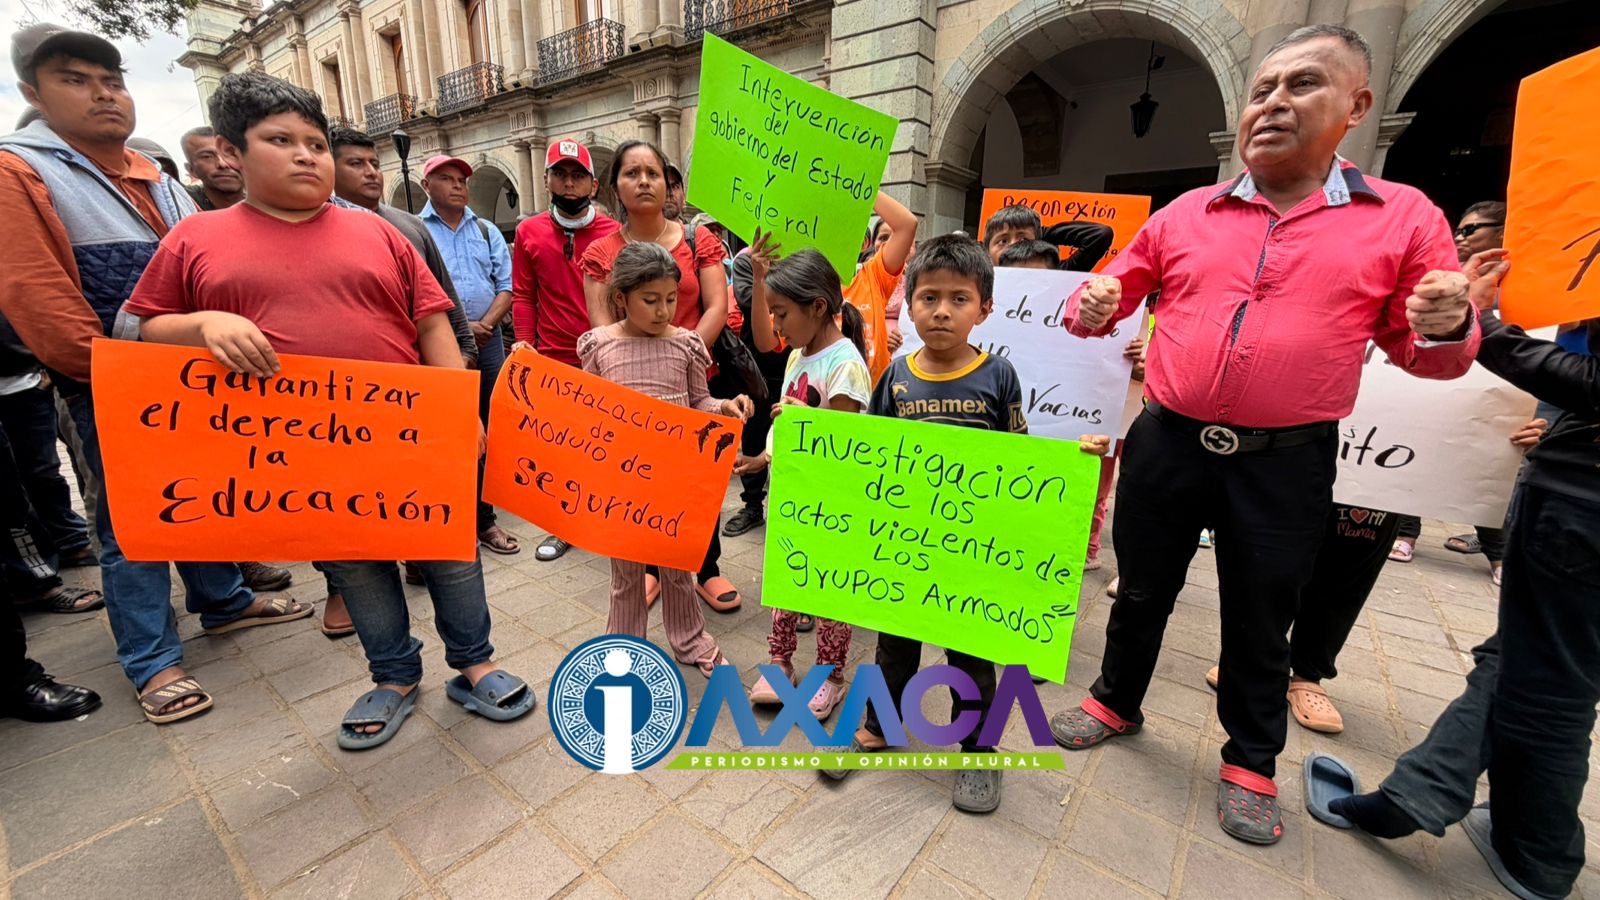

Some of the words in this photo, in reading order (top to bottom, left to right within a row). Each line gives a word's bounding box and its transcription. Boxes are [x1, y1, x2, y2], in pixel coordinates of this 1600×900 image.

[739, 64, 884, 151] Intervención
[765, 111, 788, 136] del
[710, 110, 769, 160] gobierno
[772, 146, 798, 173] del
[808, 157, 873, 200] Estado
[731, 177, 818, 239] Federal
[1005, 295, 1033, 323] de
[179, 357, 420, 410] Garantizar
[1027, 384, 1102, 424] Vacias
[139, 400, 180, 432] el
[209, 403, 372, 445] derecho
[398, 427, 419, 445] a
[896, 398, 988, 418] Banamex
[590, 421, 615, 443] de
[1340, 425, 1415, 469] ito
[248, 445, 288, 469] la
[620, 454, 652, 480] de
[791, 420, 1066, 503] Investigación
[158, 477, 451, 525] Educación
[514, 456, 685, 538] Seguridad
[865, 473, 910, 509] de
[1367, 511, 1388, 526] MY
[780, 501, 852, 533] actos
[1035, 553, 1071, 585] de
